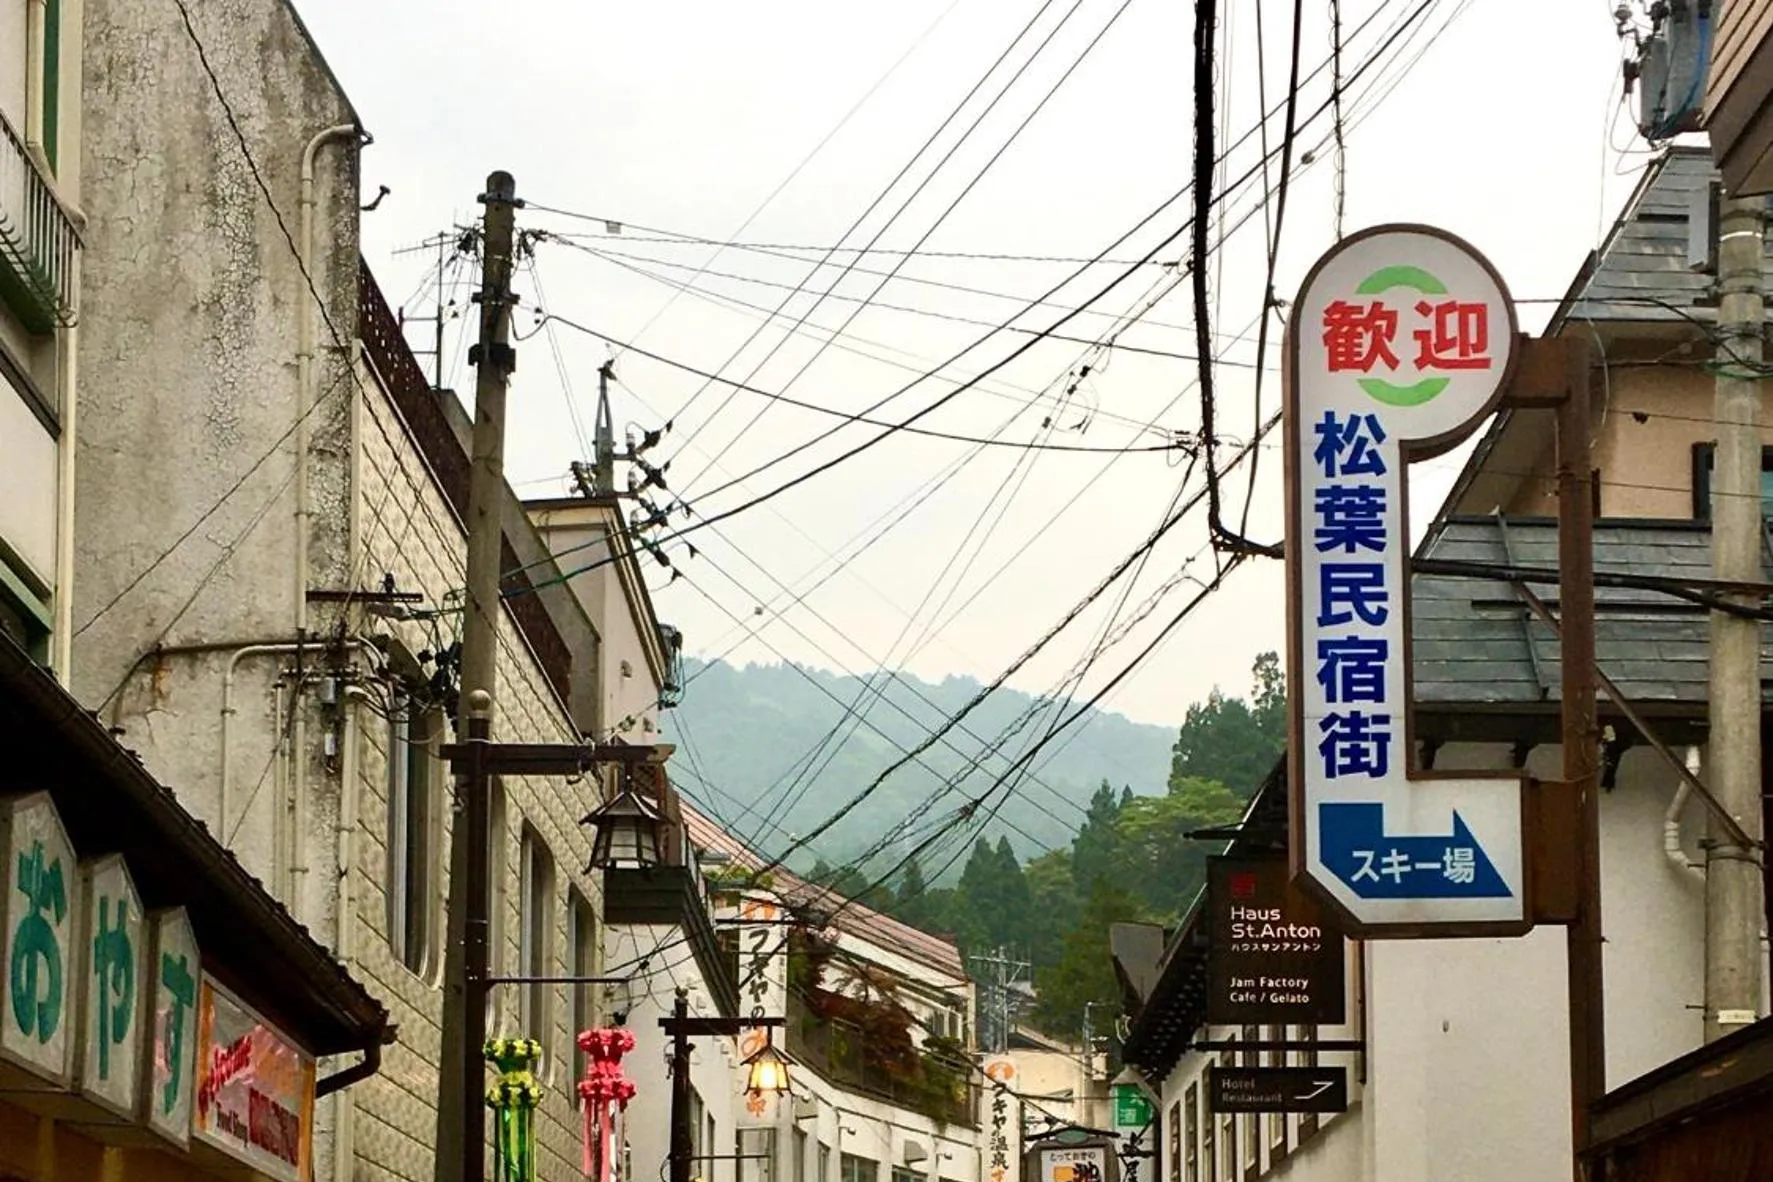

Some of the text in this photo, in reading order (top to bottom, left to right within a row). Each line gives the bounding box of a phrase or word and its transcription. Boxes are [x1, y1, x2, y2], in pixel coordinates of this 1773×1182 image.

[1322, 299, 1493, 374] 歓迎
[1314, 410, 1391, 780] 松葉民宿街
[1350, 846, 1477, 884] スキー場
[1230, 906, 1281, 921] Haus
[1231, 923, 1321, 939] St.Anton
[1230, 976, 1309, 990] Jam Factory
[1230, 992, 1257, 1003] Cafe
[1269, 992, 1310, 1004] Gelato
[1222, 1077, 1256, 1090] Hotel
